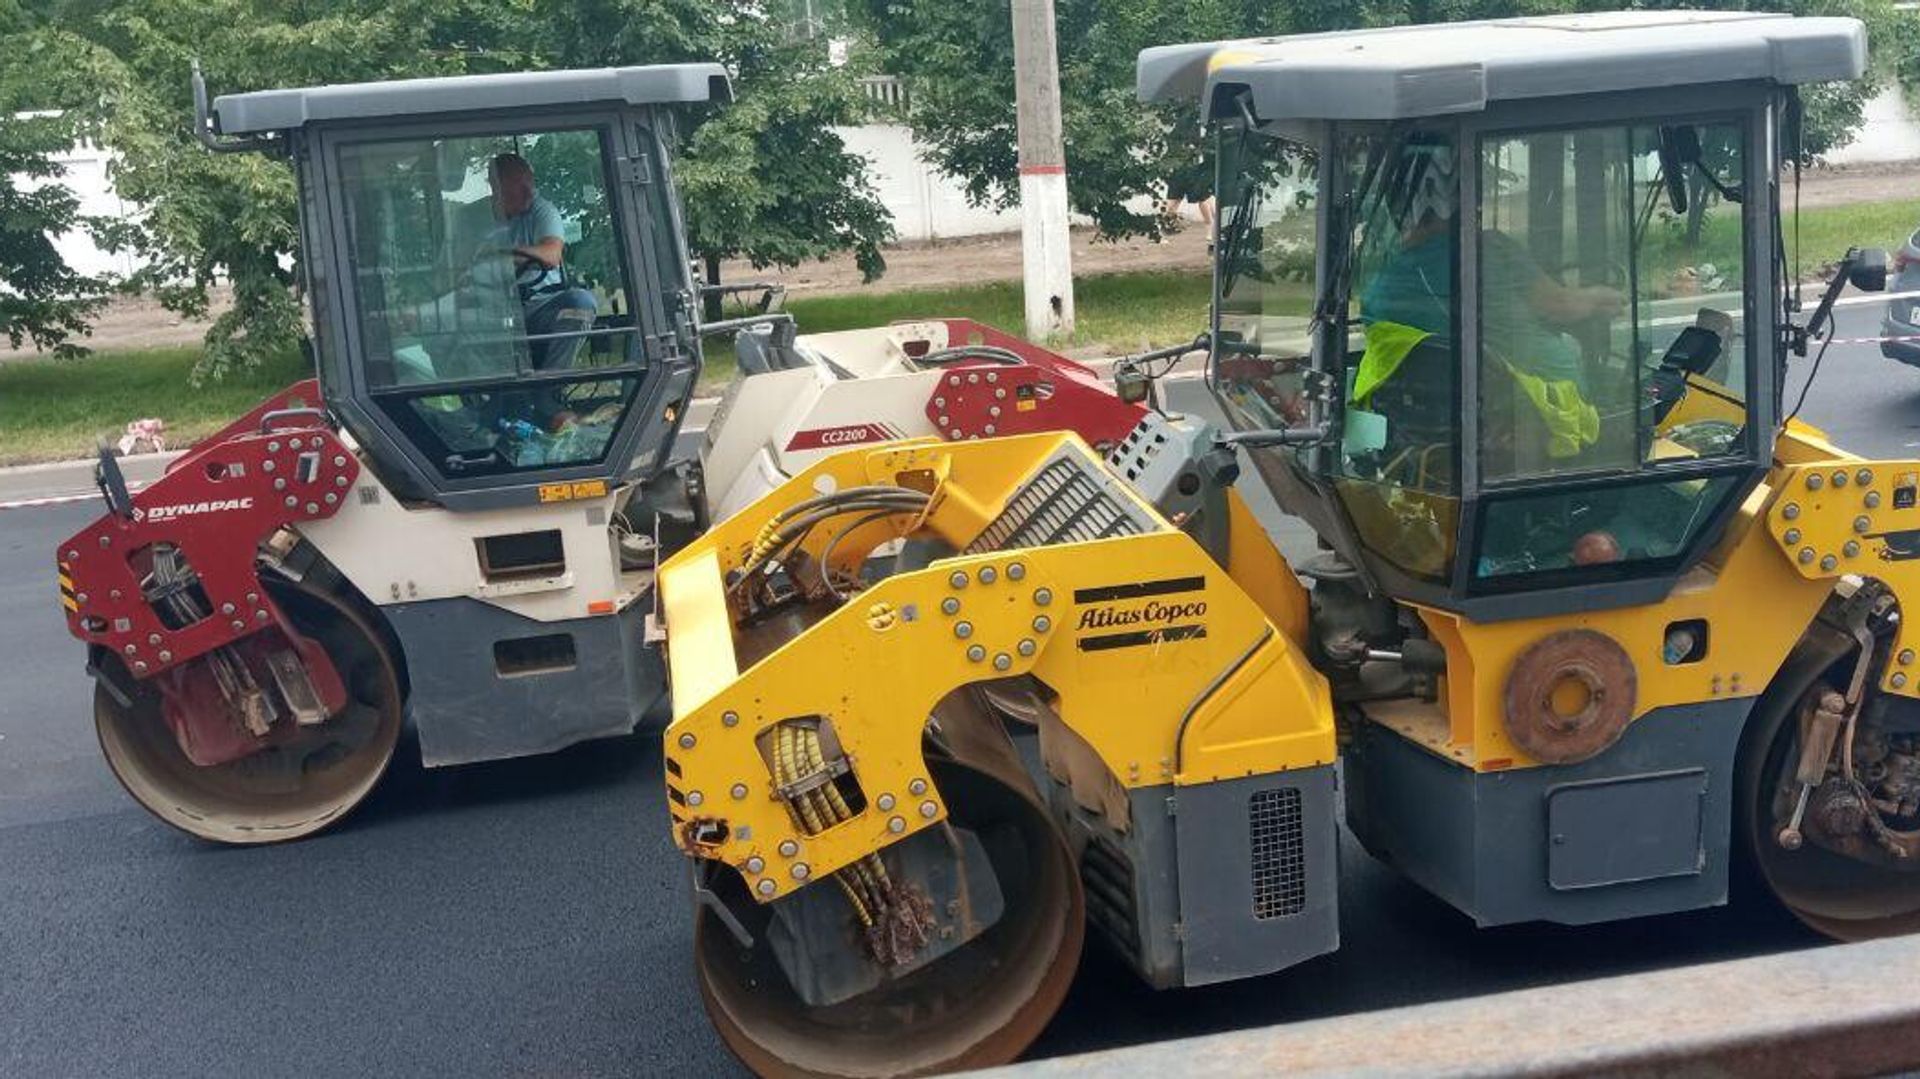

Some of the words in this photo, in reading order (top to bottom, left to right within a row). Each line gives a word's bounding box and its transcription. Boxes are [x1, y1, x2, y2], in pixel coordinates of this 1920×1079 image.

[821, 428, 868, 443] CC2200
[148, 498, 253, 518] DYNAPAC
[1075, 606, 1141, 631] Atlas
[1143, 601, 1207, 623] Copco
